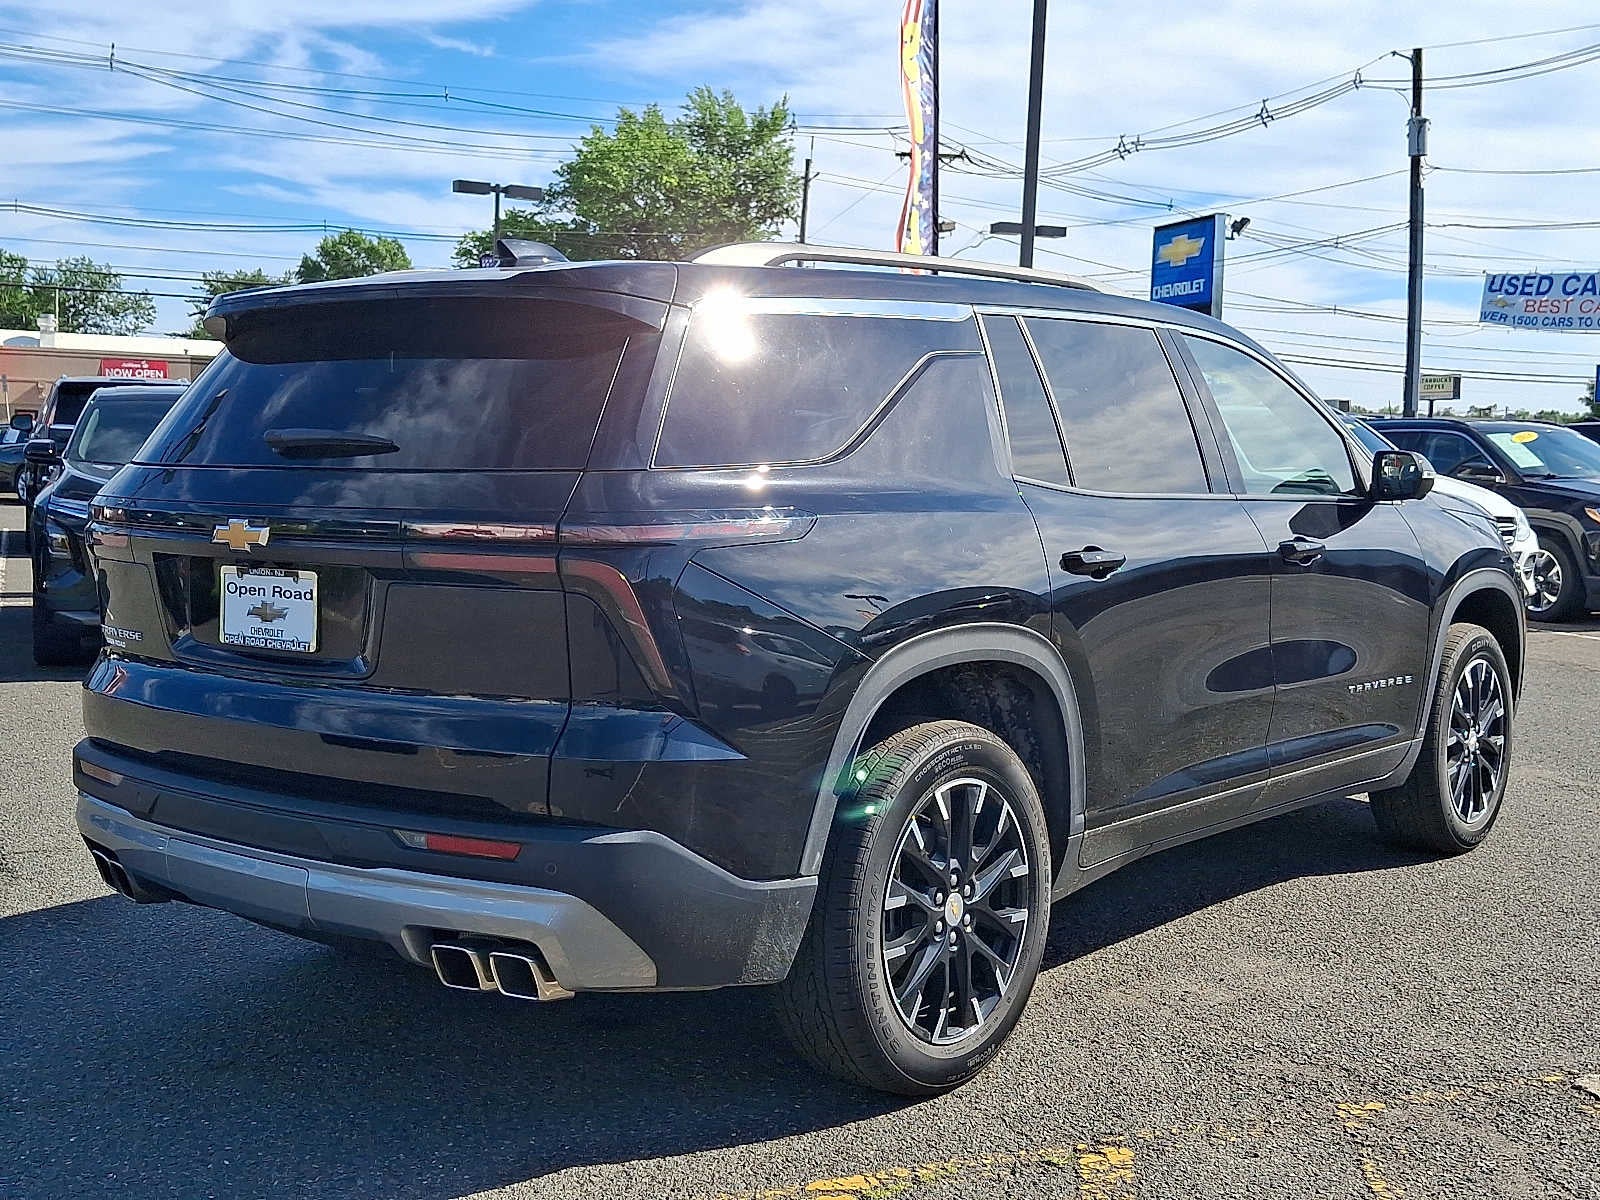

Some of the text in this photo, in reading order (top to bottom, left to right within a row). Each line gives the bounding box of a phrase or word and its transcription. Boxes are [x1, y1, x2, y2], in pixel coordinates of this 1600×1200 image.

[1152, 278, 1206, 300] CHEVROLET
[1487, 274, 1600, 296] USED CA
[1524, 298, 1575, 314] BEST
[1480, 311, 1508, 323] VER
[1511, 315, 1539, 327] 1500
[1541, 316, 1574, 328] CARS
[1579, 317, 1594, 328] TO
[105, 367, 164, 379] NOW OPEN
[226, 581, 314, 601] Open Road
[101, 623, 143, 641] TRAVERSE
[250, 626, 285, 638] CHEVROLET
[224, 634, 310, 651] OPEN ROAD CHEVROLET
[1348, 675, 1414, 694] TRAVERSE
